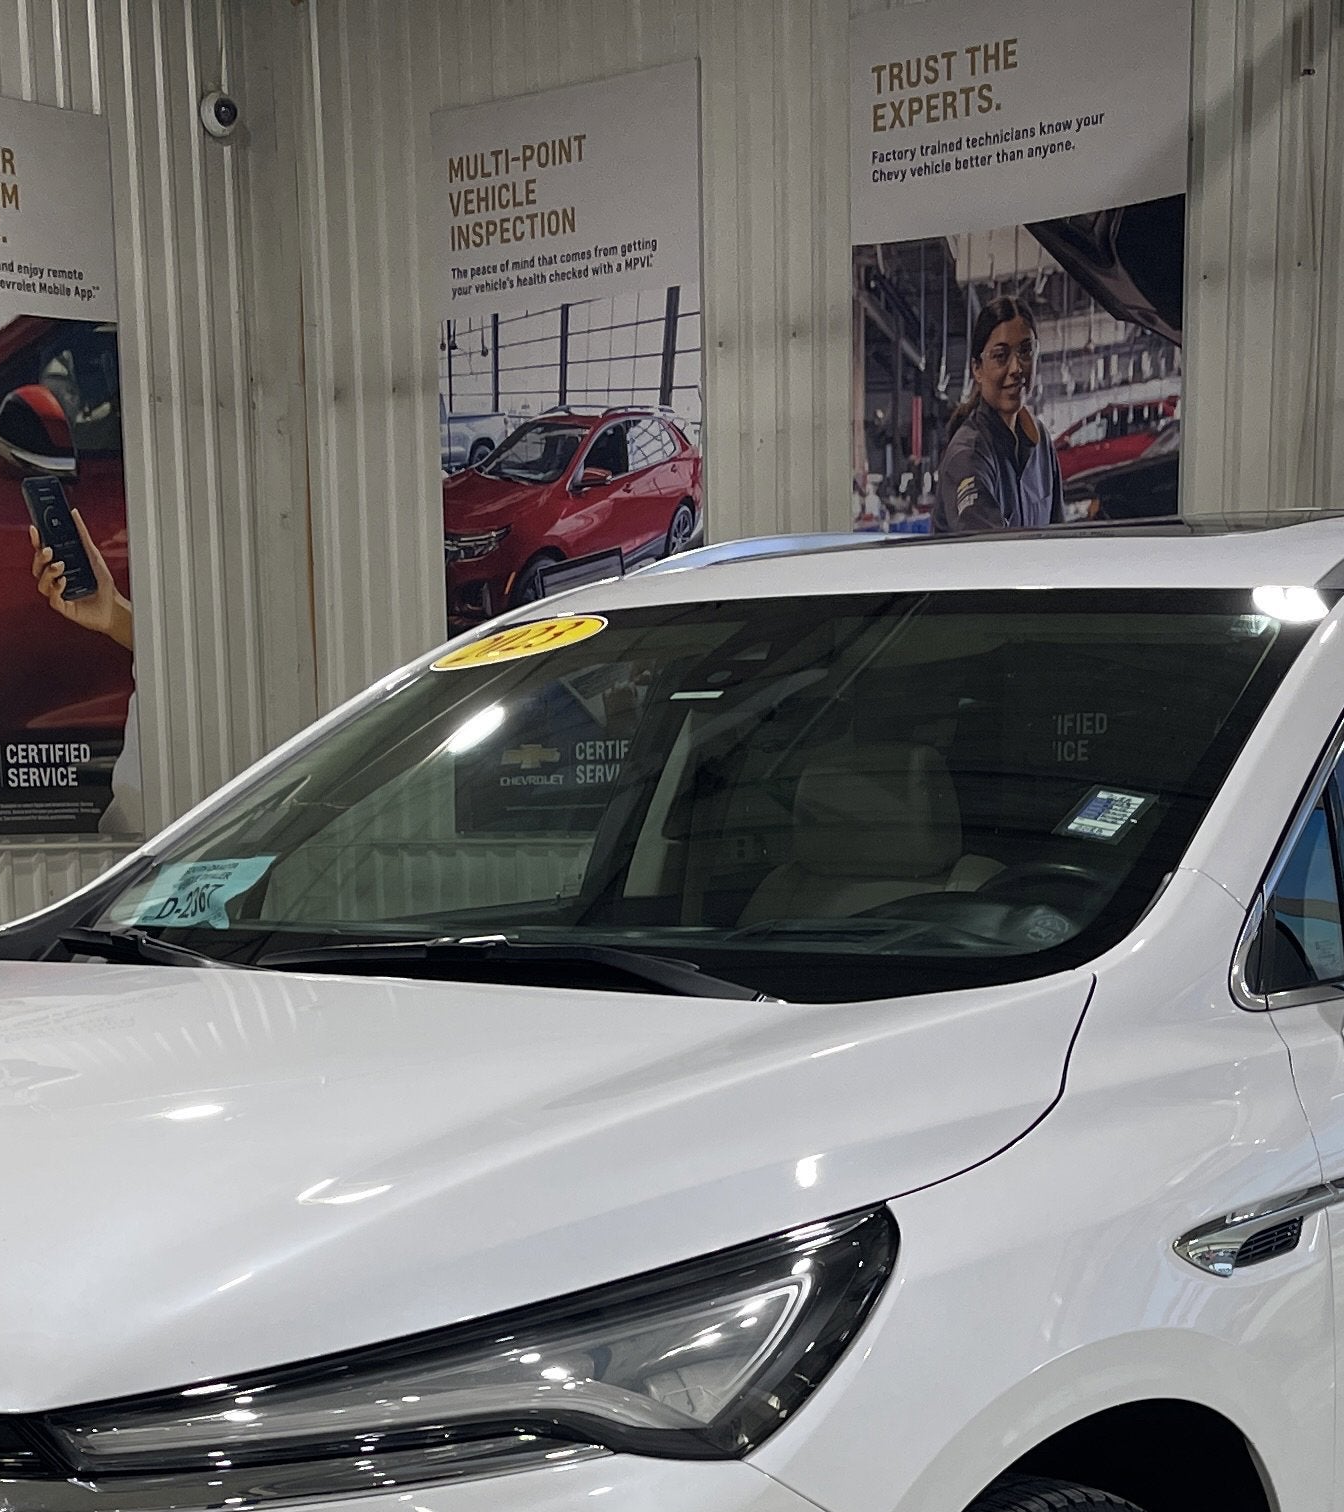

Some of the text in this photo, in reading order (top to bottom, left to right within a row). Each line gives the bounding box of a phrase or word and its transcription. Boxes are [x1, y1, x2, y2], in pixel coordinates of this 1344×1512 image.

[871, 38, 1018, 95] TRUST THE
[872, 83, 1002, 133] EXPERTS.
[448, 134, 587, 184] MULTI-POINT
[871, 112, 1105, 166] Factory trained technicians know your
[871, 138, 1076, 184] Chevy vehicle better than anyone.
[448, 178, 537, 217] VEHICLE
[450, 206, 576, 252] INSPECTION
[17, 262, 45, 280] enjoy
[47, 267, 84, 281] remote
[451, 237, 658, 281] The peace of mind that comes from getting
[38, 281, 71, 297] Mobile
[451, 284, 472, 300] your
[474, 277, 514, 294] vehicle's
[516, 271, 547, 287] health
[548, 263, 589, 283] checked
[591, 259, 613, 276] with
[615, 262, 622, 273] a
[1052, 712, 1108, 735] IFIED
[5, 743, 91, 765] CERTIFIED
[1052, 739, 1089, 762] ICE
[7, 767, 79, 788] SERVICE
[500, 774, 565, 787] CHEVROLET
